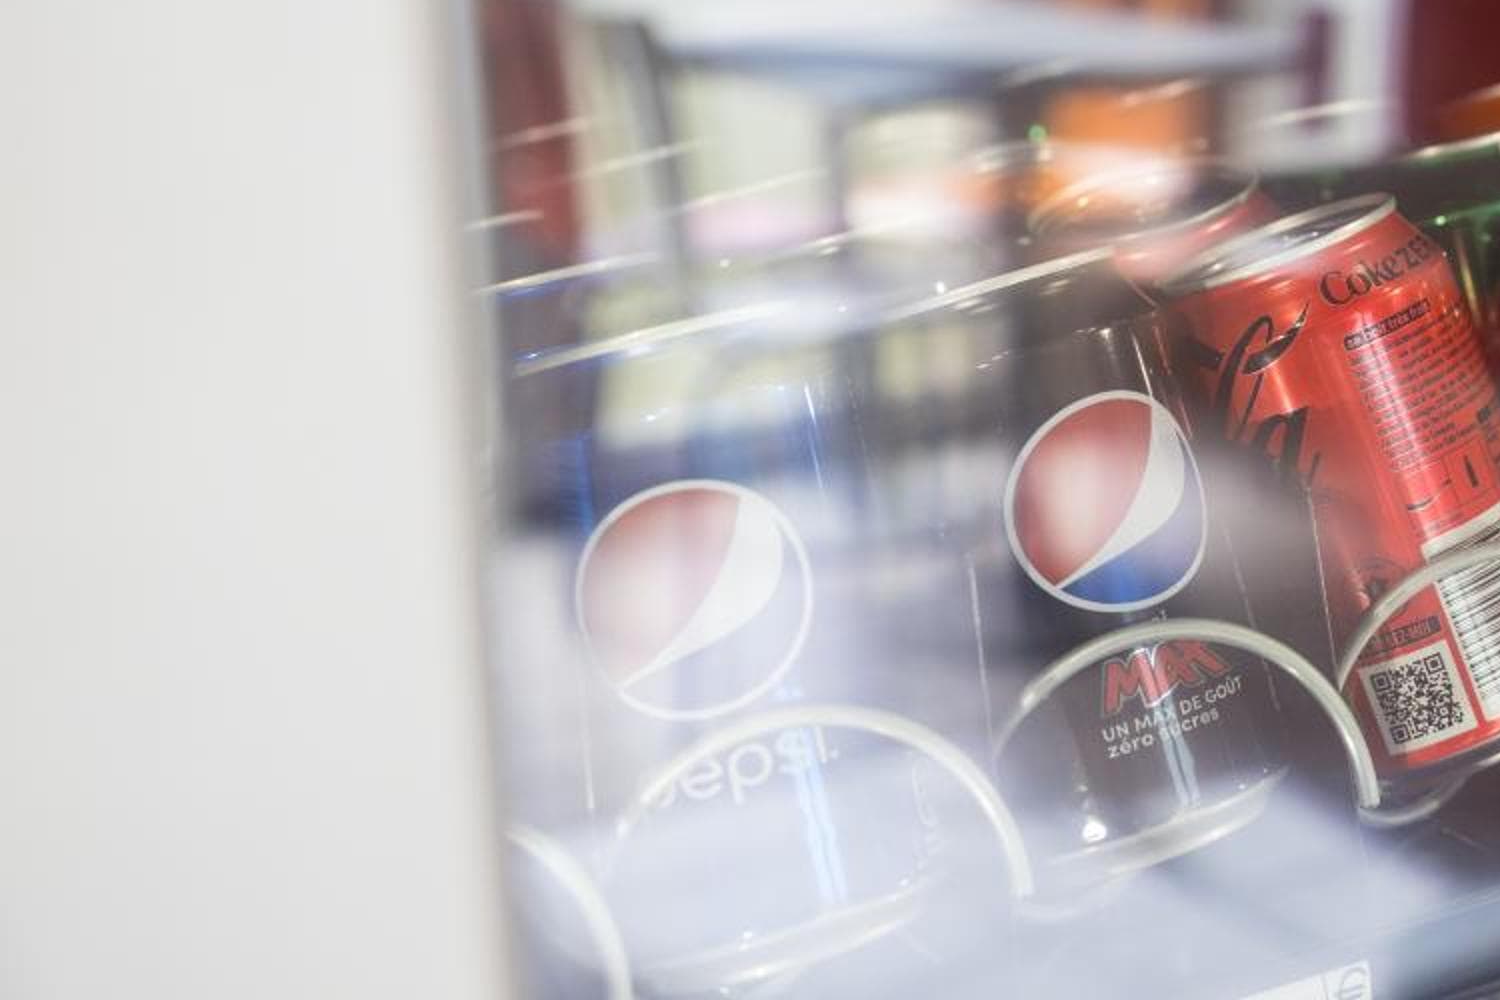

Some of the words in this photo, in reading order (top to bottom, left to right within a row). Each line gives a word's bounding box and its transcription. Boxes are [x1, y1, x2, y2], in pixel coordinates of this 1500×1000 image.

[1319, 255, 1405, 305] Coke
[1101, 722, 1130, 742] UN
[1179, 695, 1203, 716] DE
[1107, 733, 1154, 759] zéro
[1158, 707, 1220, 742] sucres
[655, 725, 830, 808] epsi
